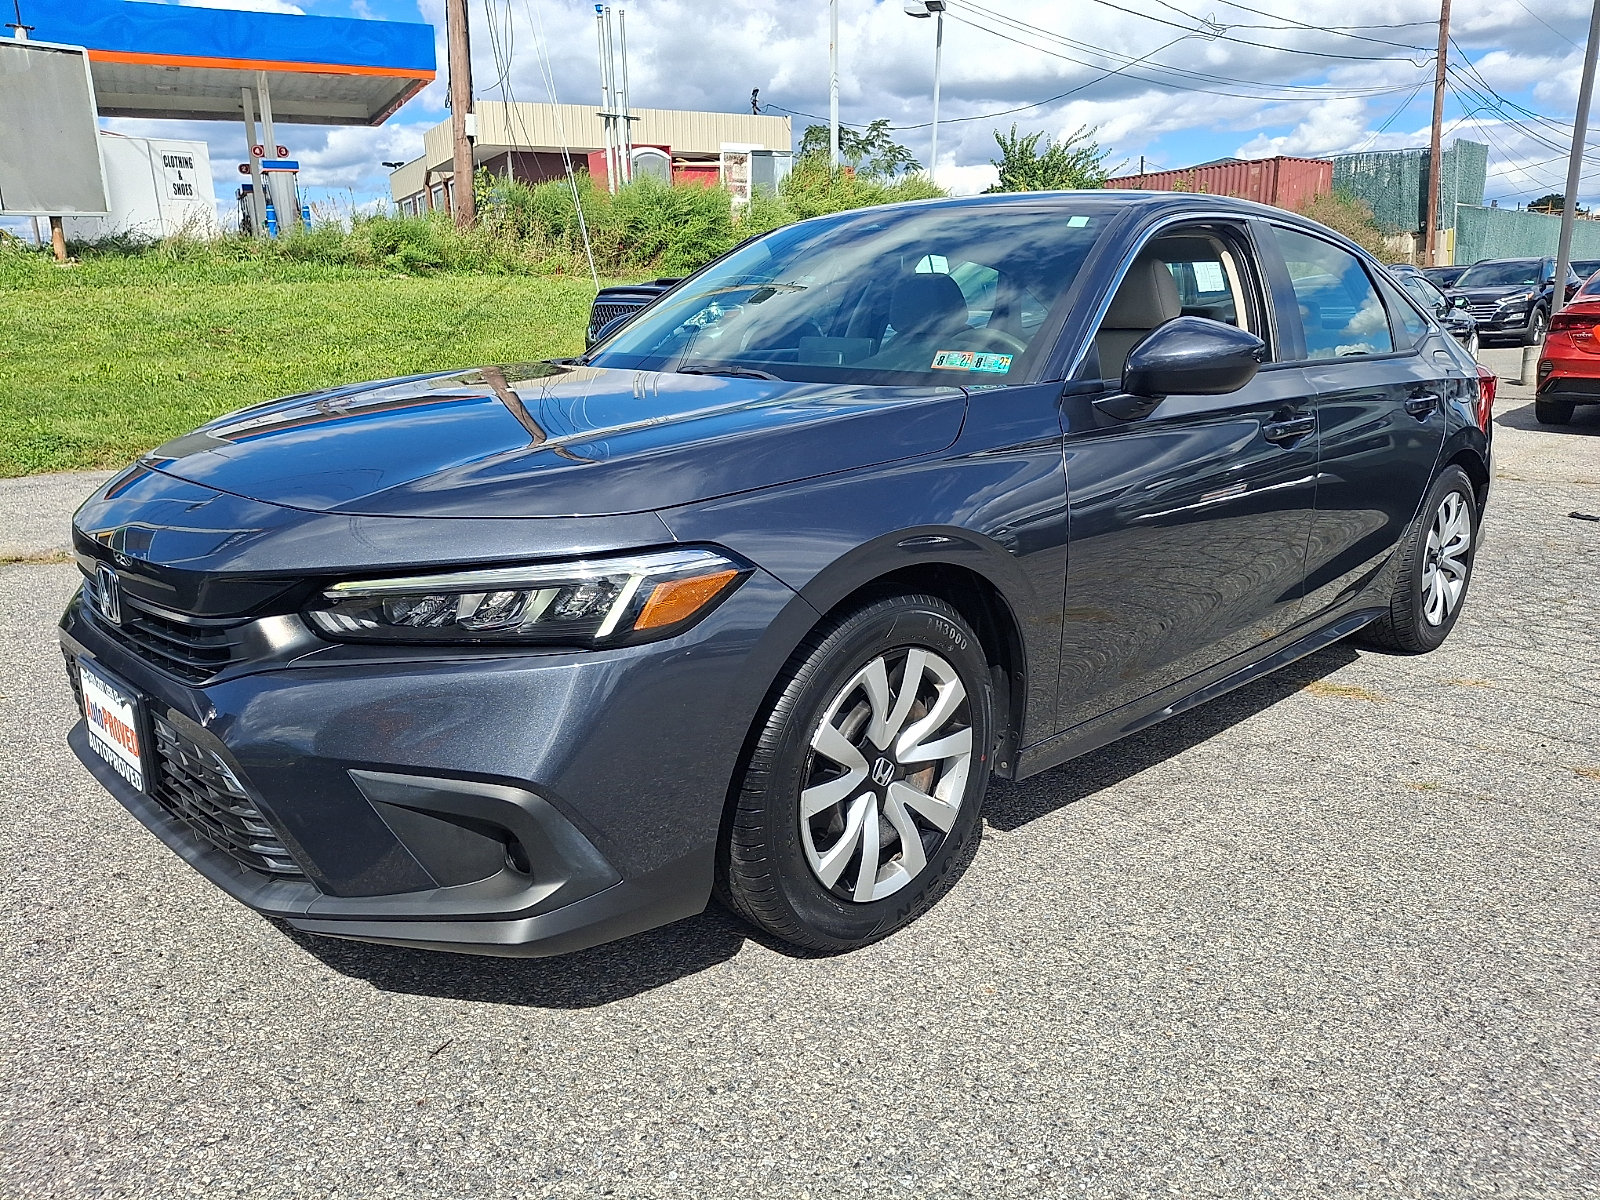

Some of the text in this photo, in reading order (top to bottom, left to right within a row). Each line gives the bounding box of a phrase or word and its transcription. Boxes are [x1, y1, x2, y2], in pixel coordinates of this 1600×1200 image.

[163, 155, 194, 169] CLOTHING
[178, 170, 183, 181] &
[172, 183, 194, 197] SHOES
[937, 355, 946, 366] 8
[975, 357, 984, 369] 8
[85, 693, 141, 758] AutoPROVED
[88, 731, 143, 793] AUTOPROVED
